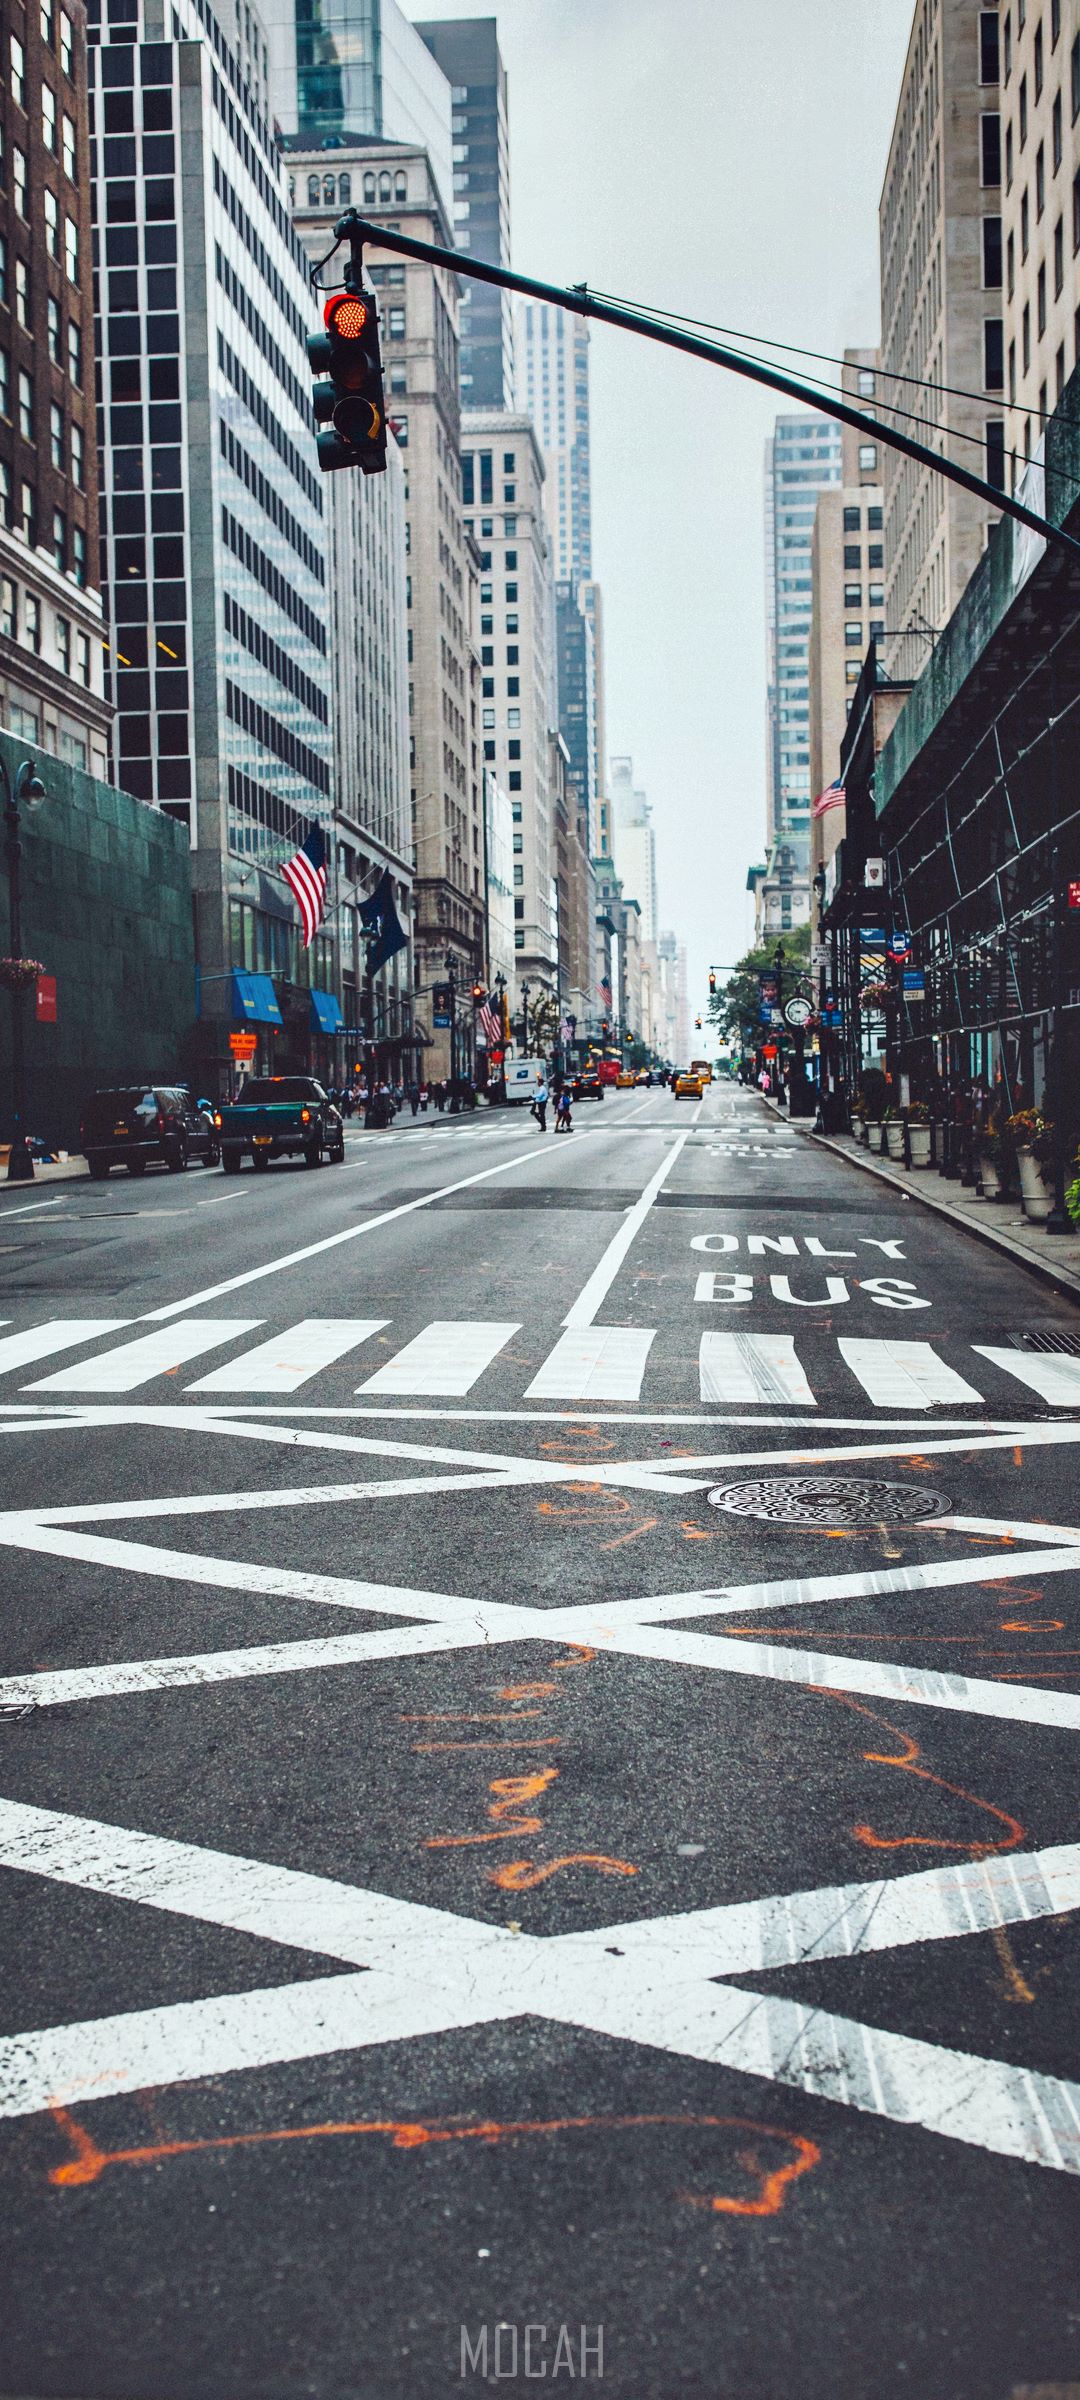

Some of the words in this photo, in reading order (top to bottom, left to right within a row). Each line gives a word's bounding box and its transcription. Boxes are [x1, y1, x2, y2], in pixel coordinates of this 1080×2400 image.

[704, 1143, 797, 1153] ONLY
[710, 1151, 793, 1159] BUS
[689, 1234, 908, 1259] ONLY
[693, 1271, 933, 1310] BUS
